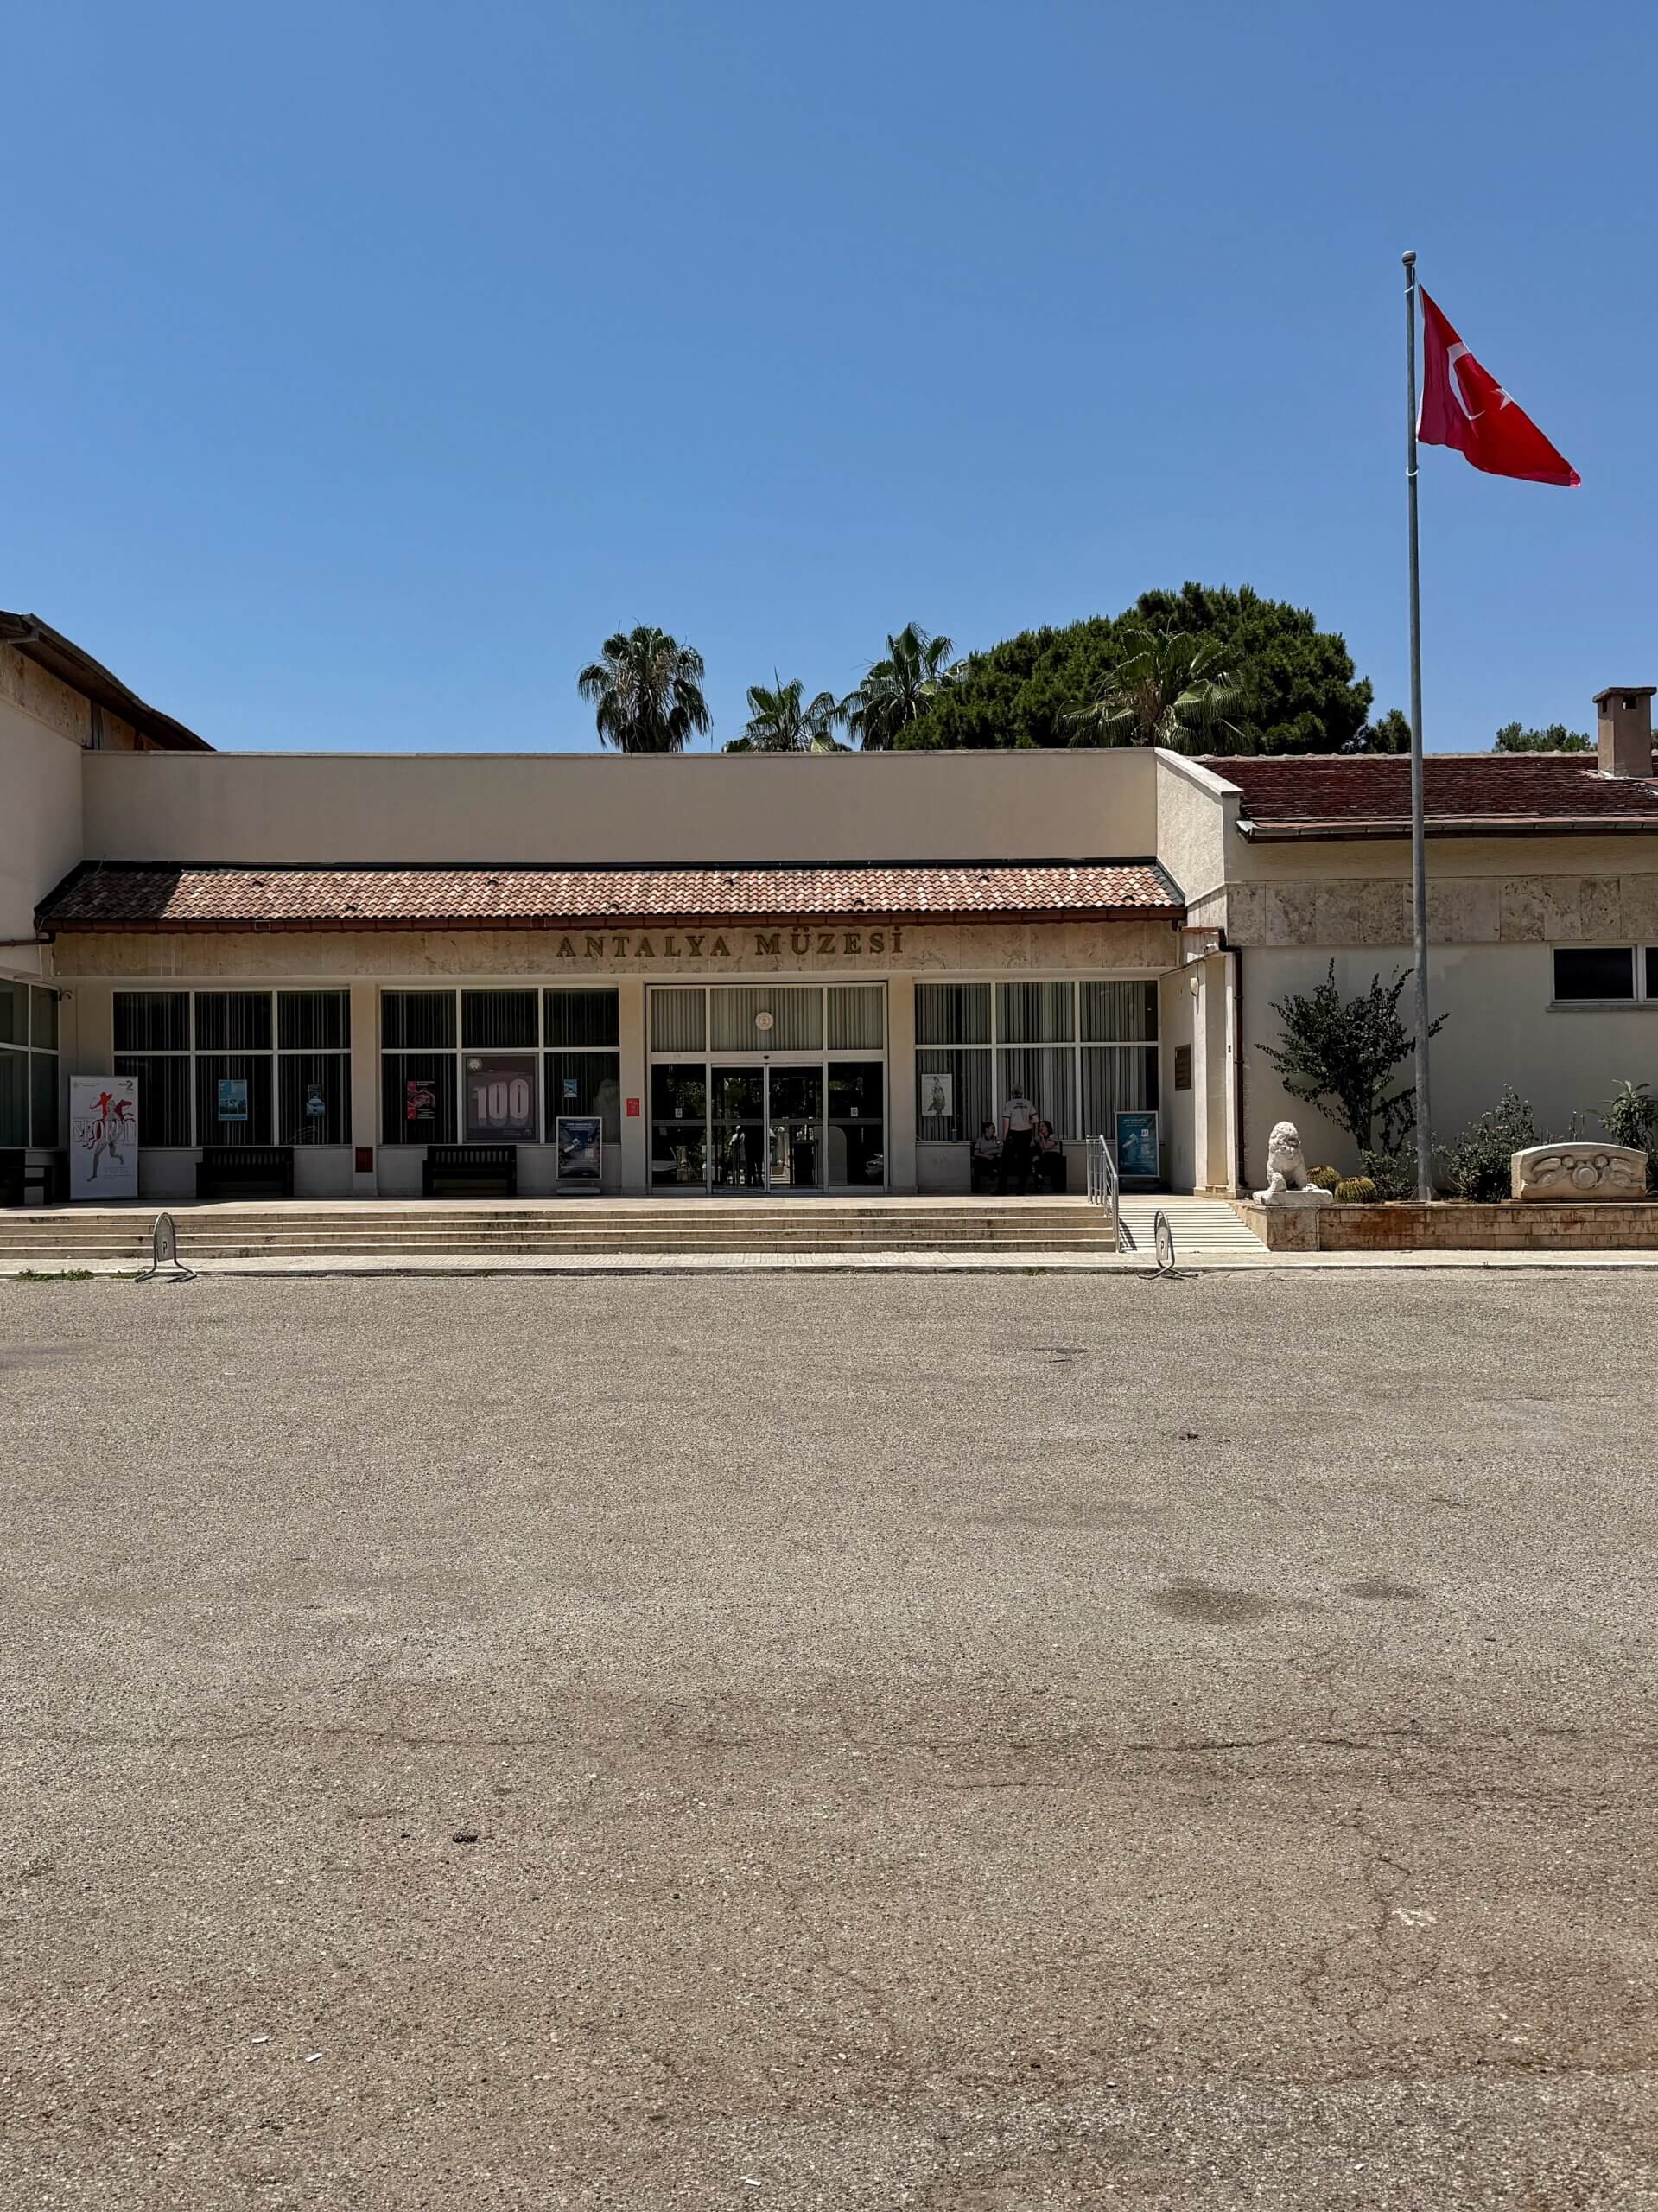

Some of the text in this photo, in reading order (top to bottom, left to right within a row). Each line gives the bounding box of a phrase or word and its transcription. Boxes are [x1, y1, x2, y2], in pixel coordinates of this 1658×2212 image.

[556, 926, 904, 957] ANTALYA MÜZESİ
[470, 1077, 529, 1120] 100
